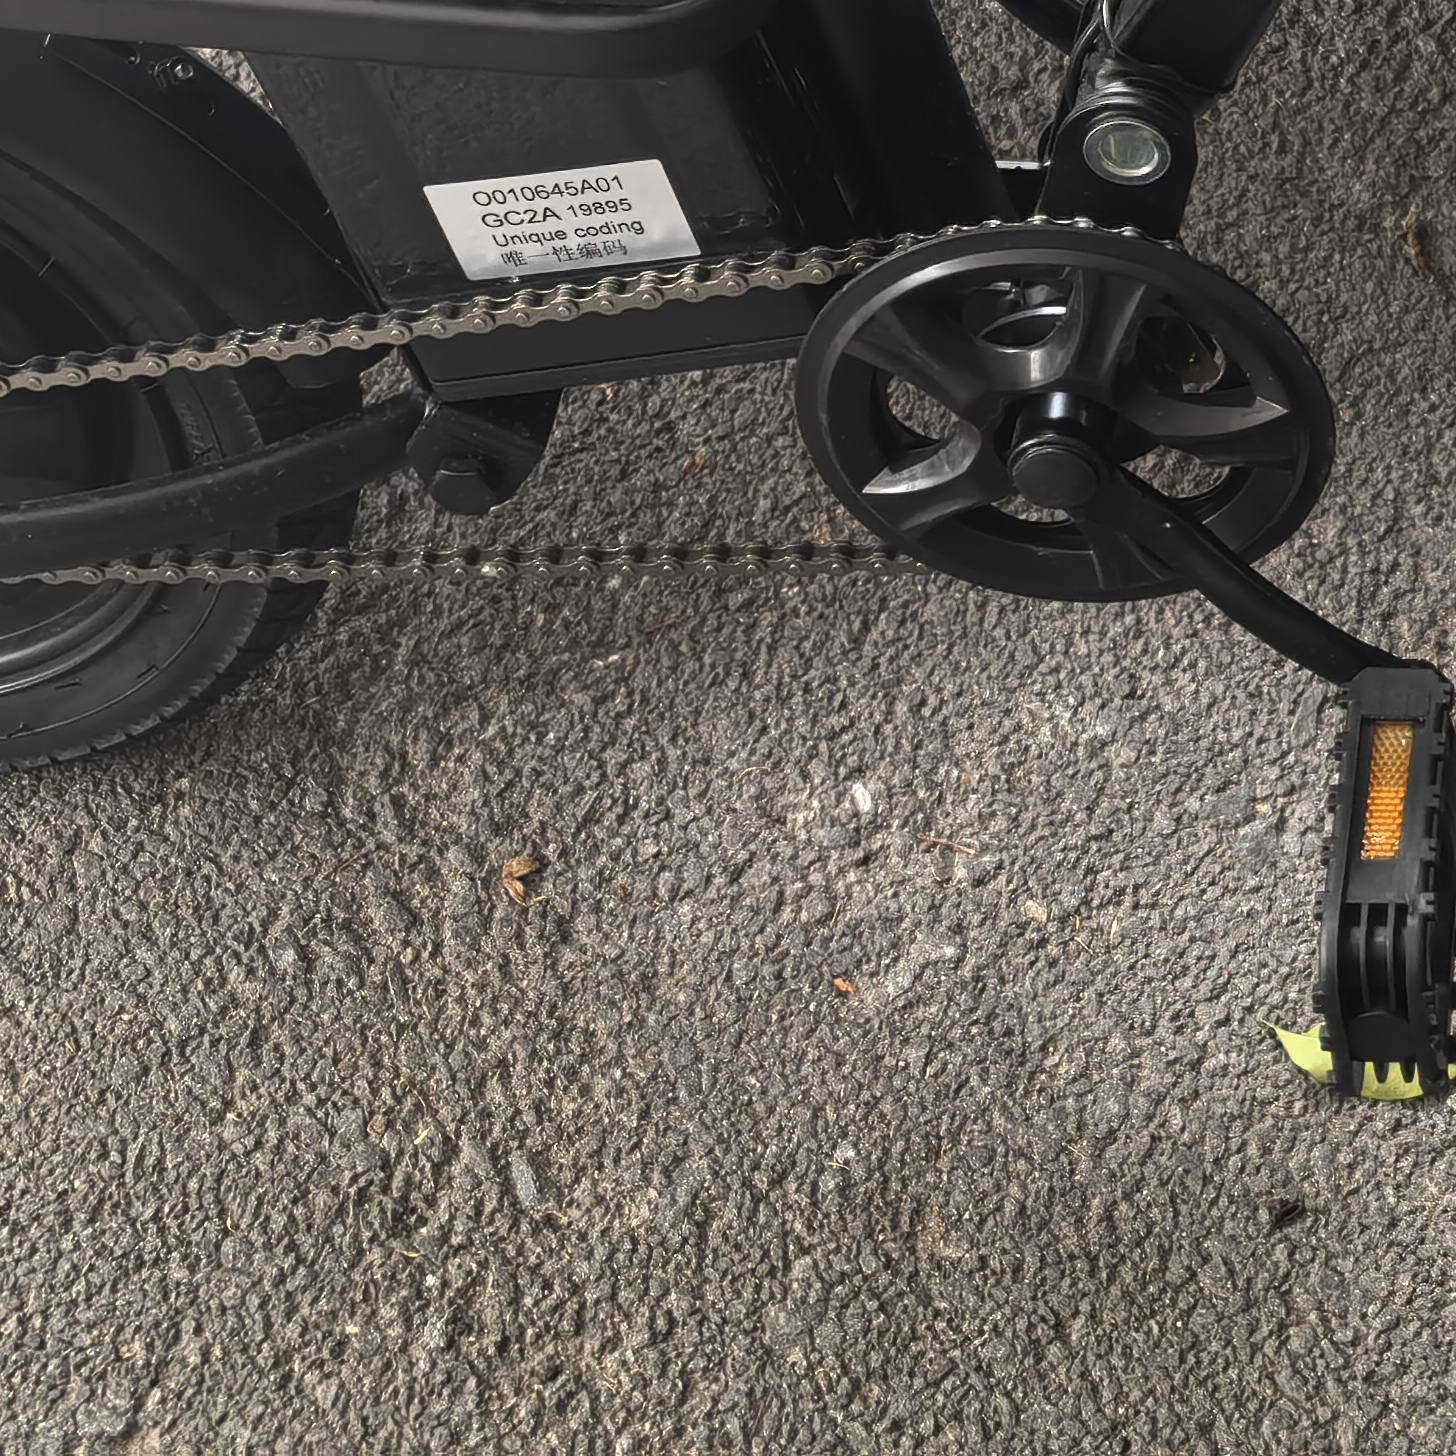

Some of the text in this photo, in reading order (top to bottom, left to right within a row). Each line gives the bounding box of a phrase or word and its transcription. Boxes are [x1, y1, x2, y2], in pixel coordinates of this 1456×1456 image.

[481, 197, 633, 228] GC2A 19895
[491, 218, 645, 247] Unique coding
[500, 240, 628, 268] 唯一性编码
